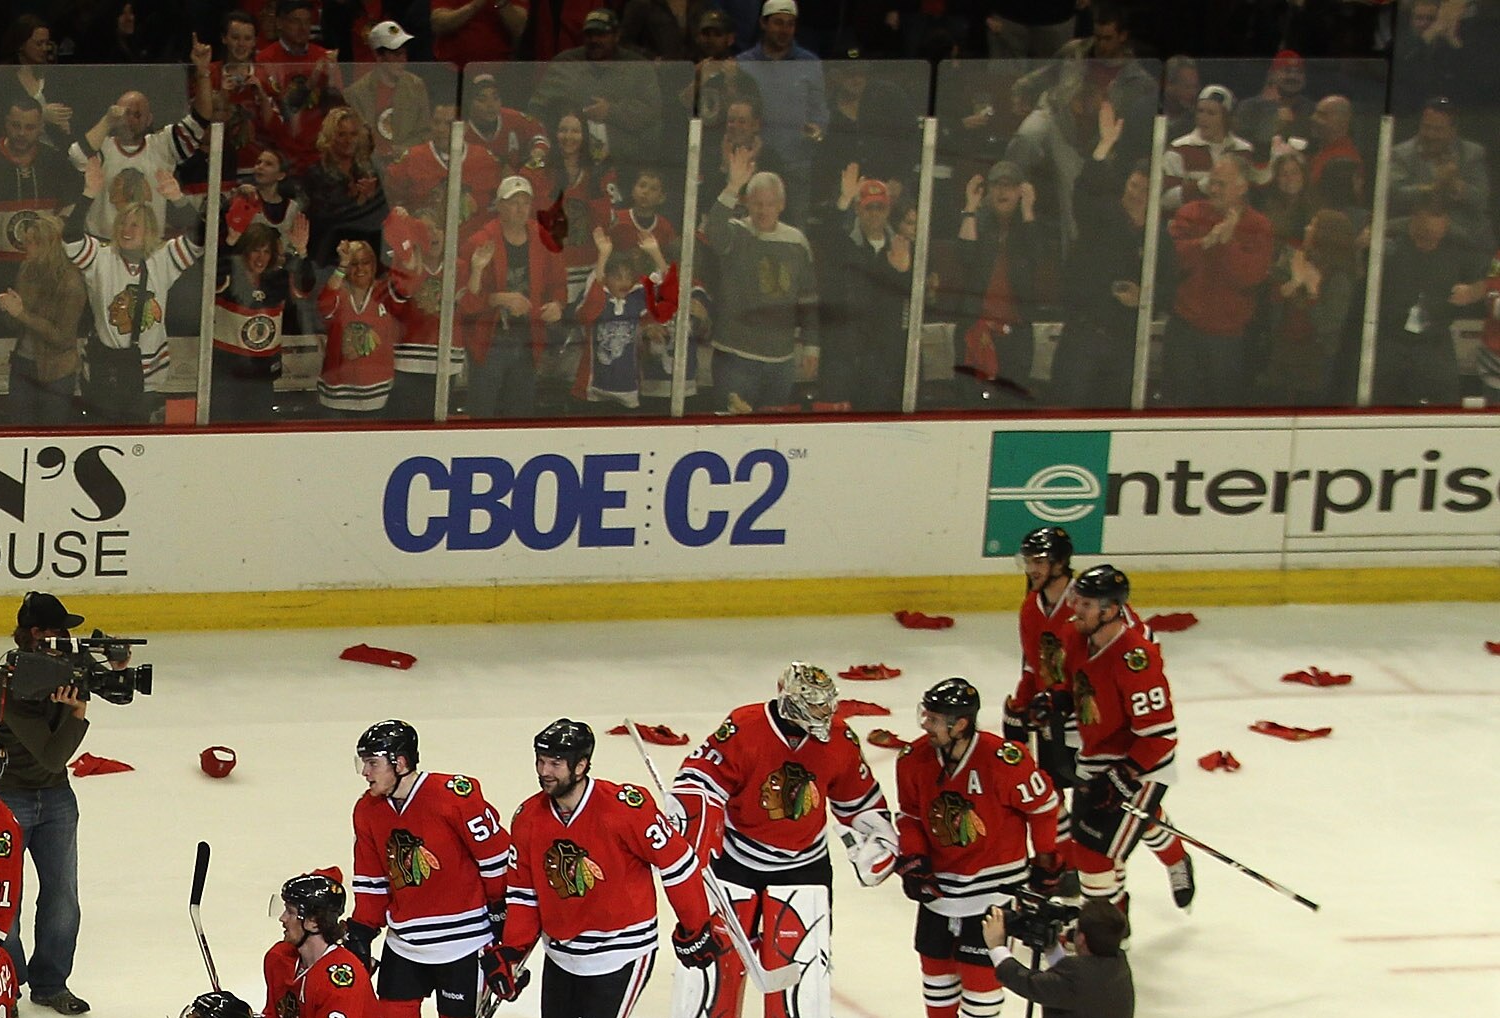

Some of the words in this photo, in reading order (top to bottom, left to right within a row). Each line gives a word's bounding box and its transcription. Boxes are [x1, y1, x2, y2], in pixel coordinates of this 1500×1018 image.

[378, 302, 388, 318] A
[383, 453, 641, 553] CBOE
[663, 448, 789, 548] C2
[988, 449, 1500, 532] enterpris
[1131, 686, 1166, 717] 29
[966, 769, 984, 795] A
[1016, 770, 1048, 804] 10
[676, 931, 711, 957] Reebok
[441, 988, 465, 1002] Reebok
